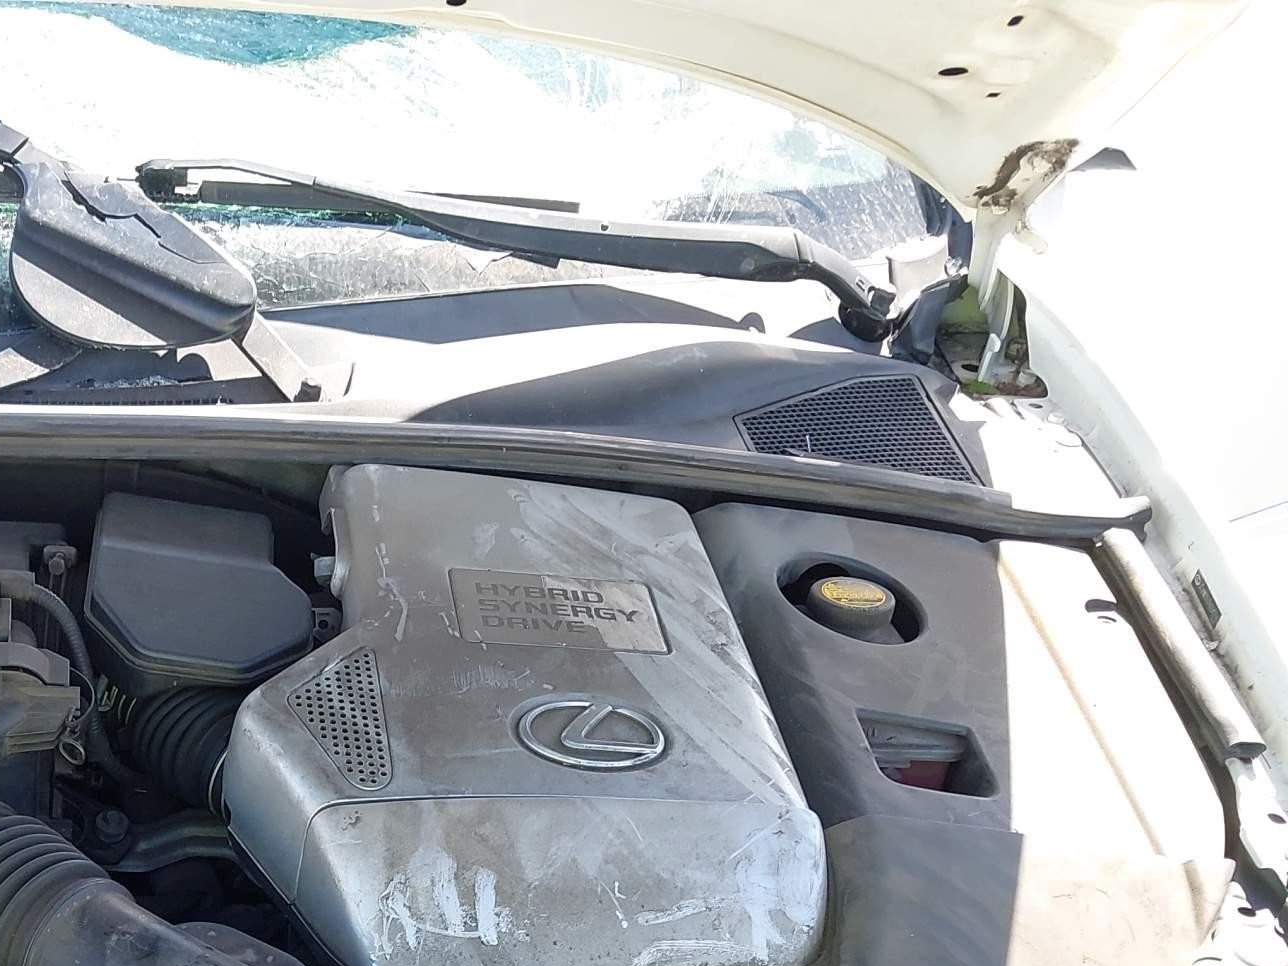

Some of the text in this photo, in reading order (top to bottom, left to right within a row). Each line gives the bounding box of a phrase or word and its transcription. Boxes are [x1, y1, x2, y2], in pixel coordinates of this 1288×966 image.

[474, 582, 604, 603] HYBRID
[478, 599, 638, 622] SYNERGY
[480, 615, 586, 633] DRIVE
